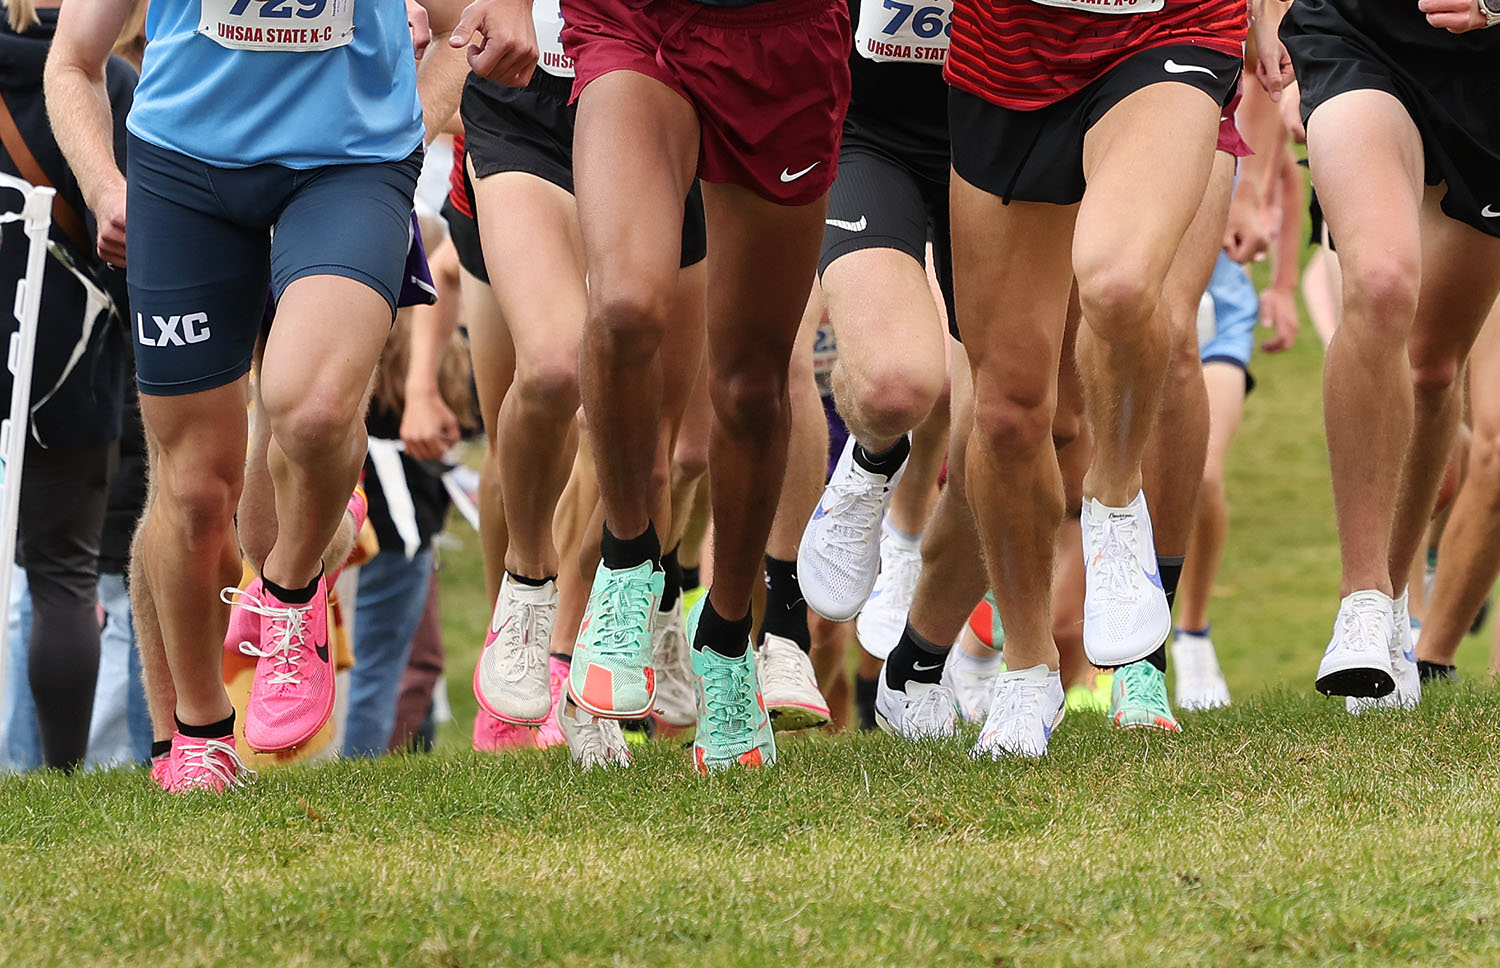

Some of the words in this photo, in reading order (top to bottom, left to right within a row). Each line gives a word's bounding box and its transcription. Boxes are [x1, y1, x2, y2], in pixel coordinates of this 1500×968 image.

[217, 22, 263, 43] UHSAA
[266, 27, 307, 44] STATE
[310, 25, 332, 43] X-C
[867, 37, 911, 60] UHSAA
[914, 46, 950, 60] STAT
[136, 311, 211, 347] LXC
